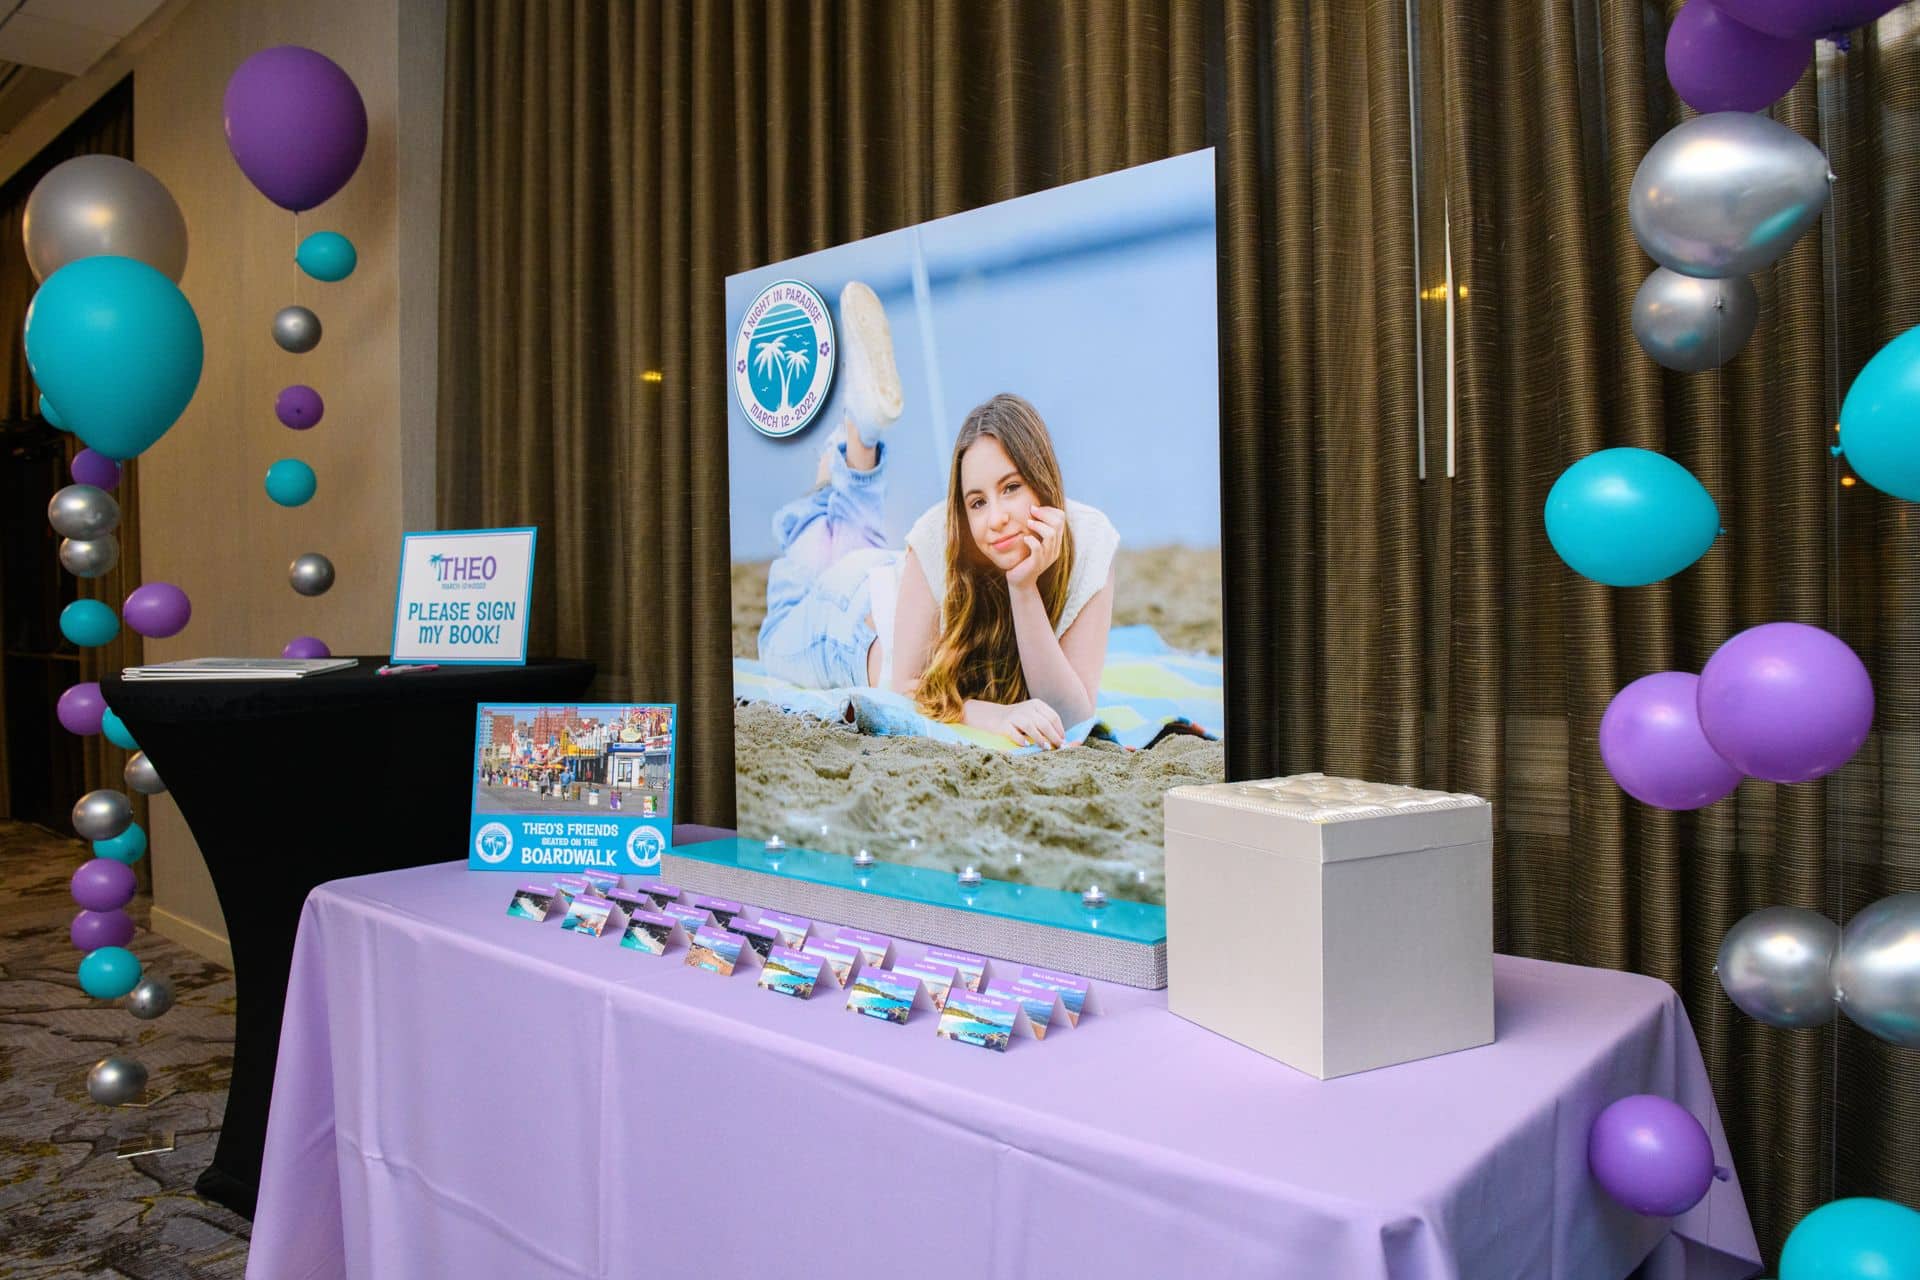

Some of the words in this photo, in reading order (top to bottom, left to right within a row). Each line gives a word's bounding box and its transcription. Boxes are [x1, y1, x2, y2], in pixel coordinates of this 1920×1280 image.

[743, 332, 750, 340] A
[748, 294, 771, 328] NIGHT
[773, 289, 783, 303] IN
[786, 287, 823, 325] PARADISE
[750, 403, 778, 428] MARCH
[441, 555, 497, 581] THEO
[408, 602, 471, 621] PLEASE
[476, 601, 516, 621] SIGN
[449, 625, 500, 644] BOOK!
[522, 822, 564, 836] THEO'S
[567, 823, 619, 837] FRIENDS
[570, 838, 582, 846] ON
[583, 838, 599, 847] THE
[521, 847, 617, 866] BOARDWALK
